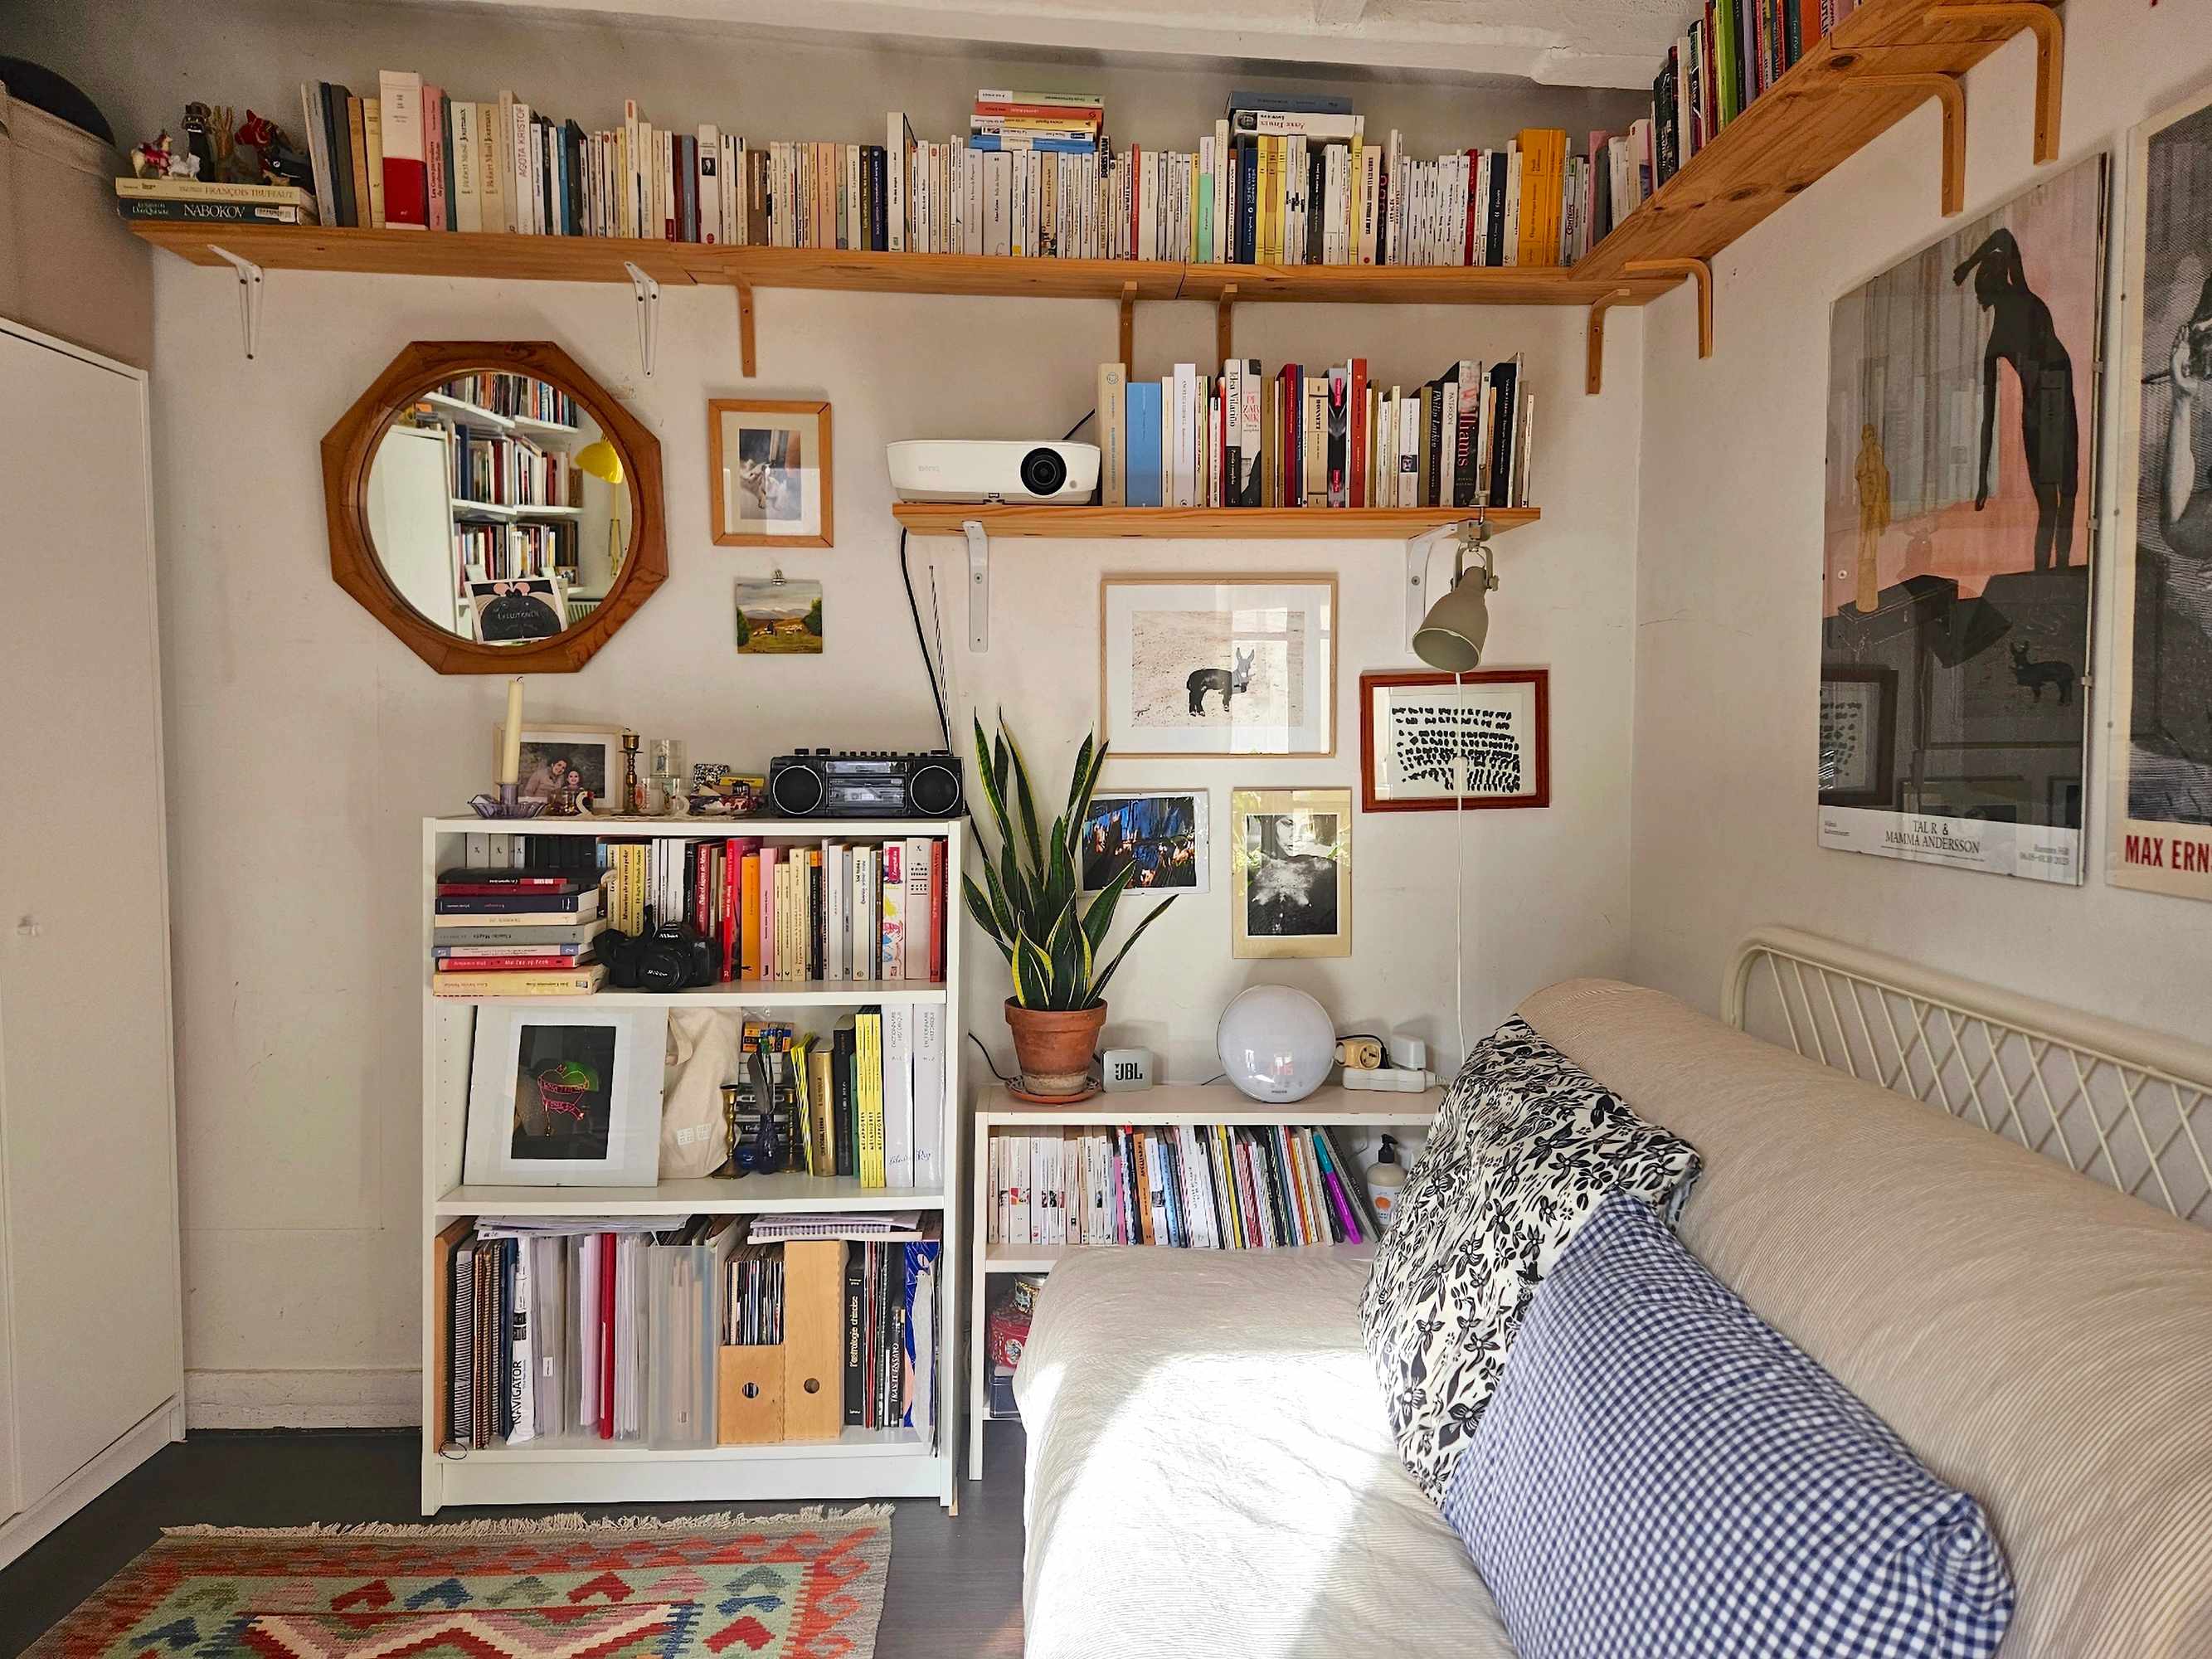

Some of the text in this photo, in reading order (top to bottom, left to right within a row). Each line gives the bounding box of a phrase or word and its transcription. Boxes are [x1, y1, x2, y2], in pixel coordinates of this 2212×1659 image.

[183, 203, 246, 219] NABOKOV
[1913, 820, 1949, 836] TAL R &
[1885, 831, 1981, 854] MAMMA ANDERSSON
[2125, 834, 2212, 873] MAX ERN
[1114, 1063, 1143, 1081] JBL
[511, 1360, 523, 1425] NAVIGATOR
